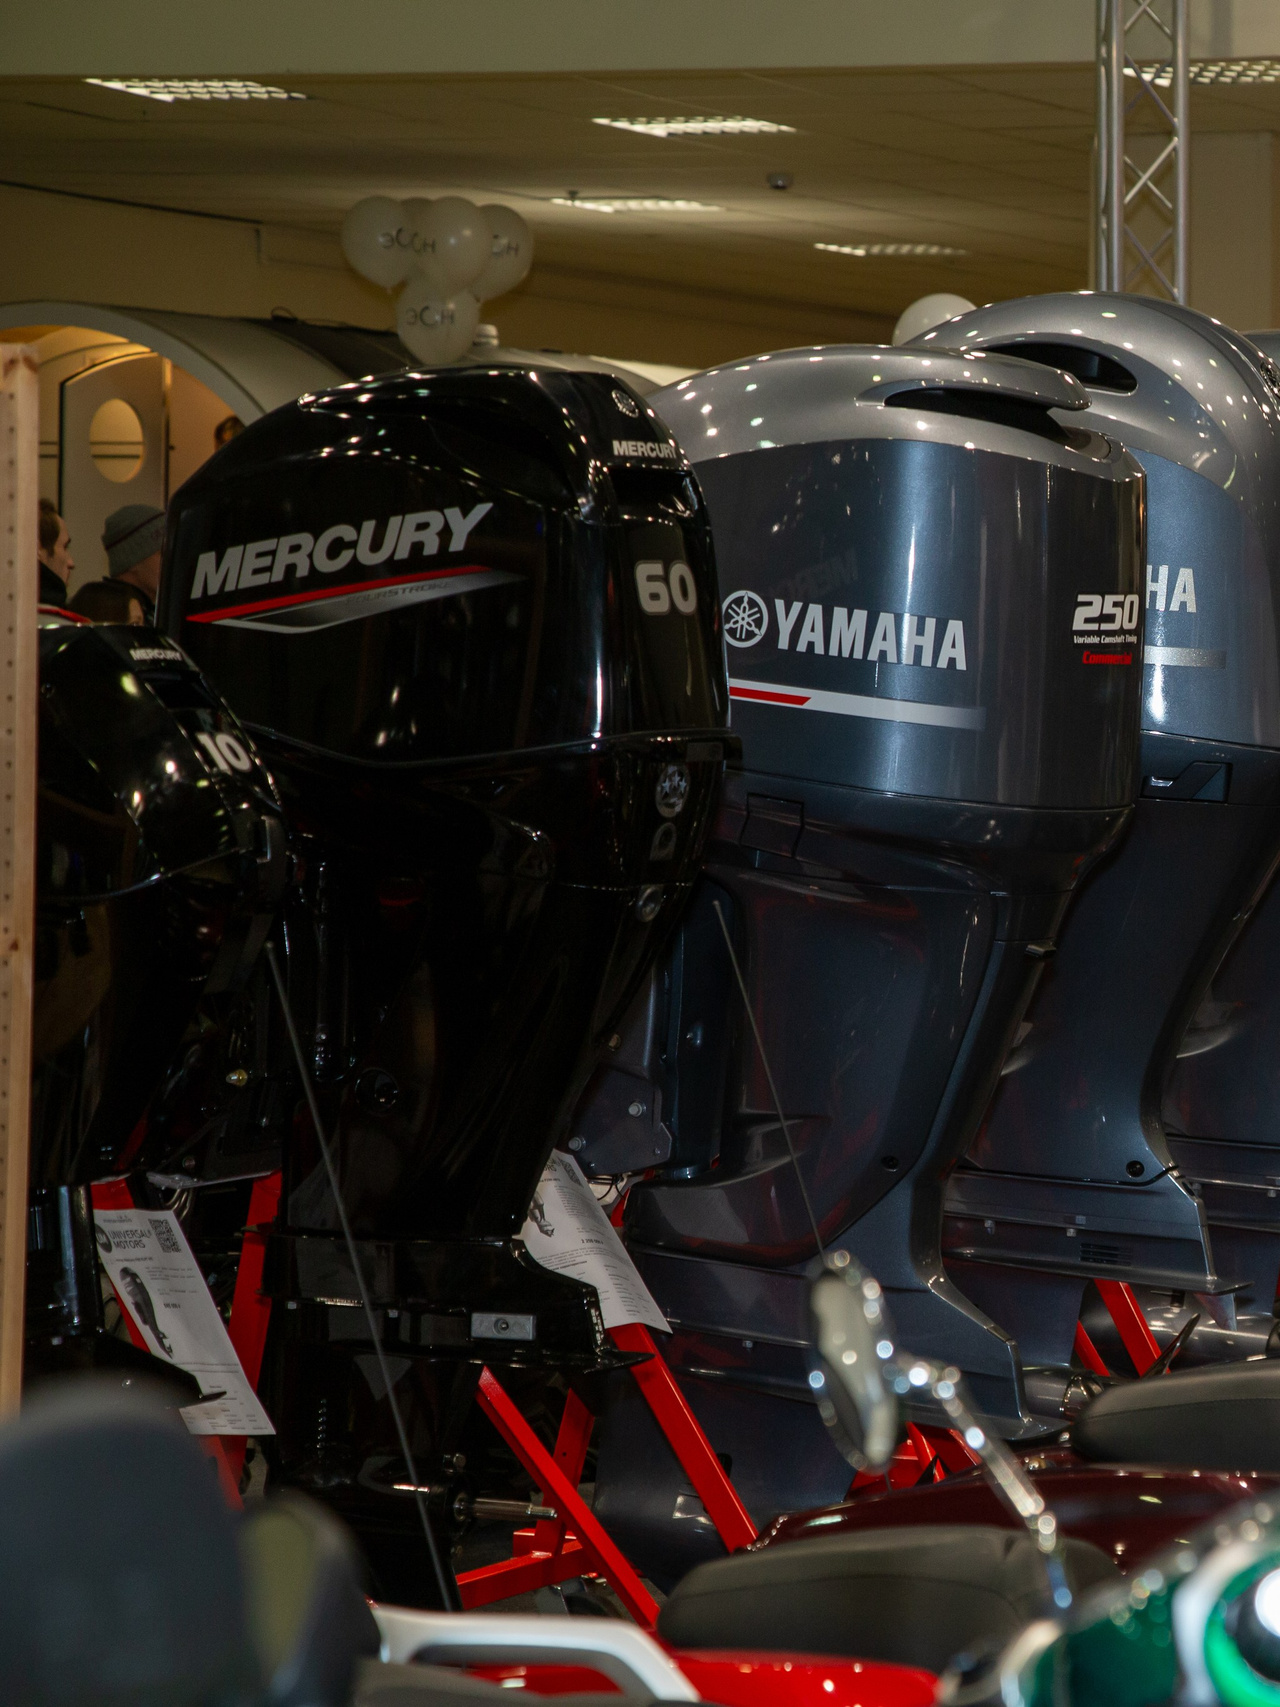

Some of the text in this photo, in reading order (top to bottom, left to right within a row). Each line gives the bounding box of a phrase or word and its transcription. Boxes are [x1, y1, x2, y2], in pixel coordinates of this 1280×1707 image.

[612, 439, 677, 459] MERCURY
[190, 502, 494, 599] MERCURY
[634, 560, 698, 616] 60
[1072, 594, 1140, 631] 250
[774, 598, 967, 671] YAMAHA
[1073, 635, 1101, 645] Variable
[1101, 635, 1125, 645] Camshaft
[129, 648, 183, 662] MERCURY
[1082, 650, 1133, 665] Commercial
[197, 732, 252, 776] 10
[107, 1229, 150, 1240] UNIVERSAL
[113, 1239, 146, 1250] MOTORS
